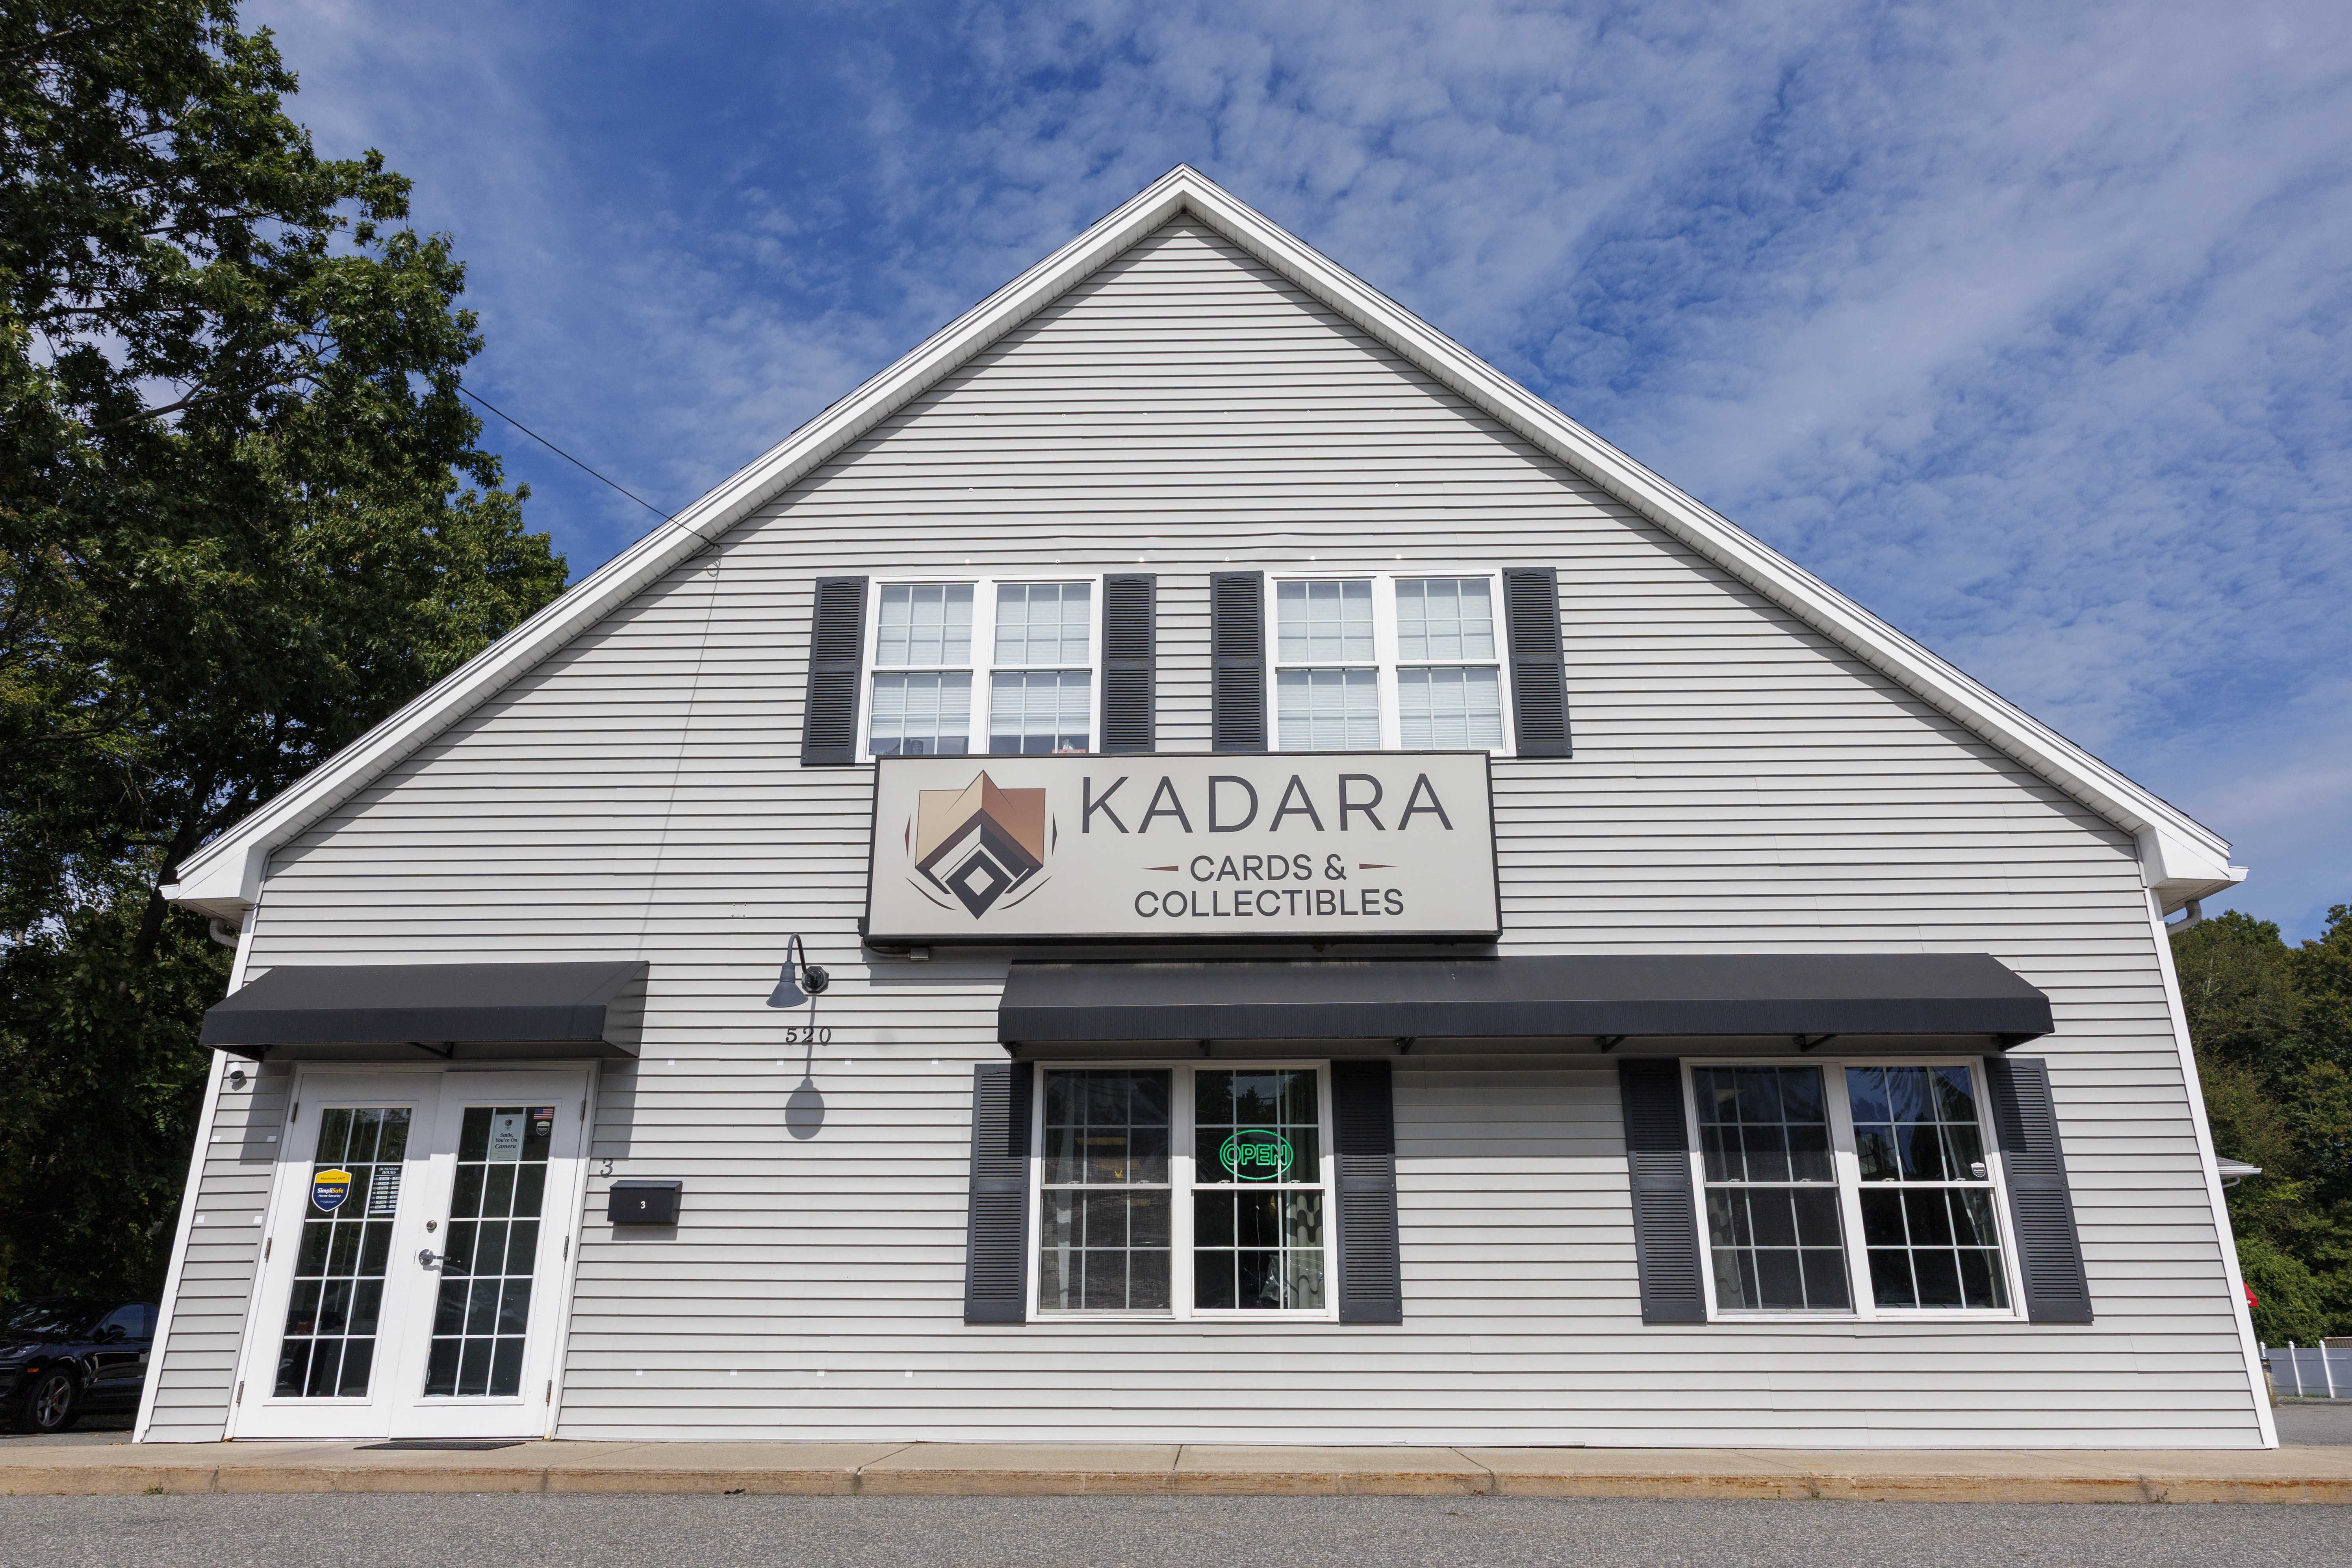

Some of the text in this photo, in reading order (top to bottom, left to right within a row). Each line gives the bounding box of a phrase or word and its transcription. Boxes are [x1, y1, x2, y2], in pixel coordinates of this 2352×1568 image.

[1082, 773, 1453, 833] KADARA
[1190, 854, 1347, 882] CARDS &
[1134, 888, 1404, 918] COLLECTIBLES
[786, 1026, 831, 1044] 520
[1223, 1143, 1287, 1166] OPEN
[600, 1158, 613, 1175] 3
[640, 1201, 646, 1209] 3
